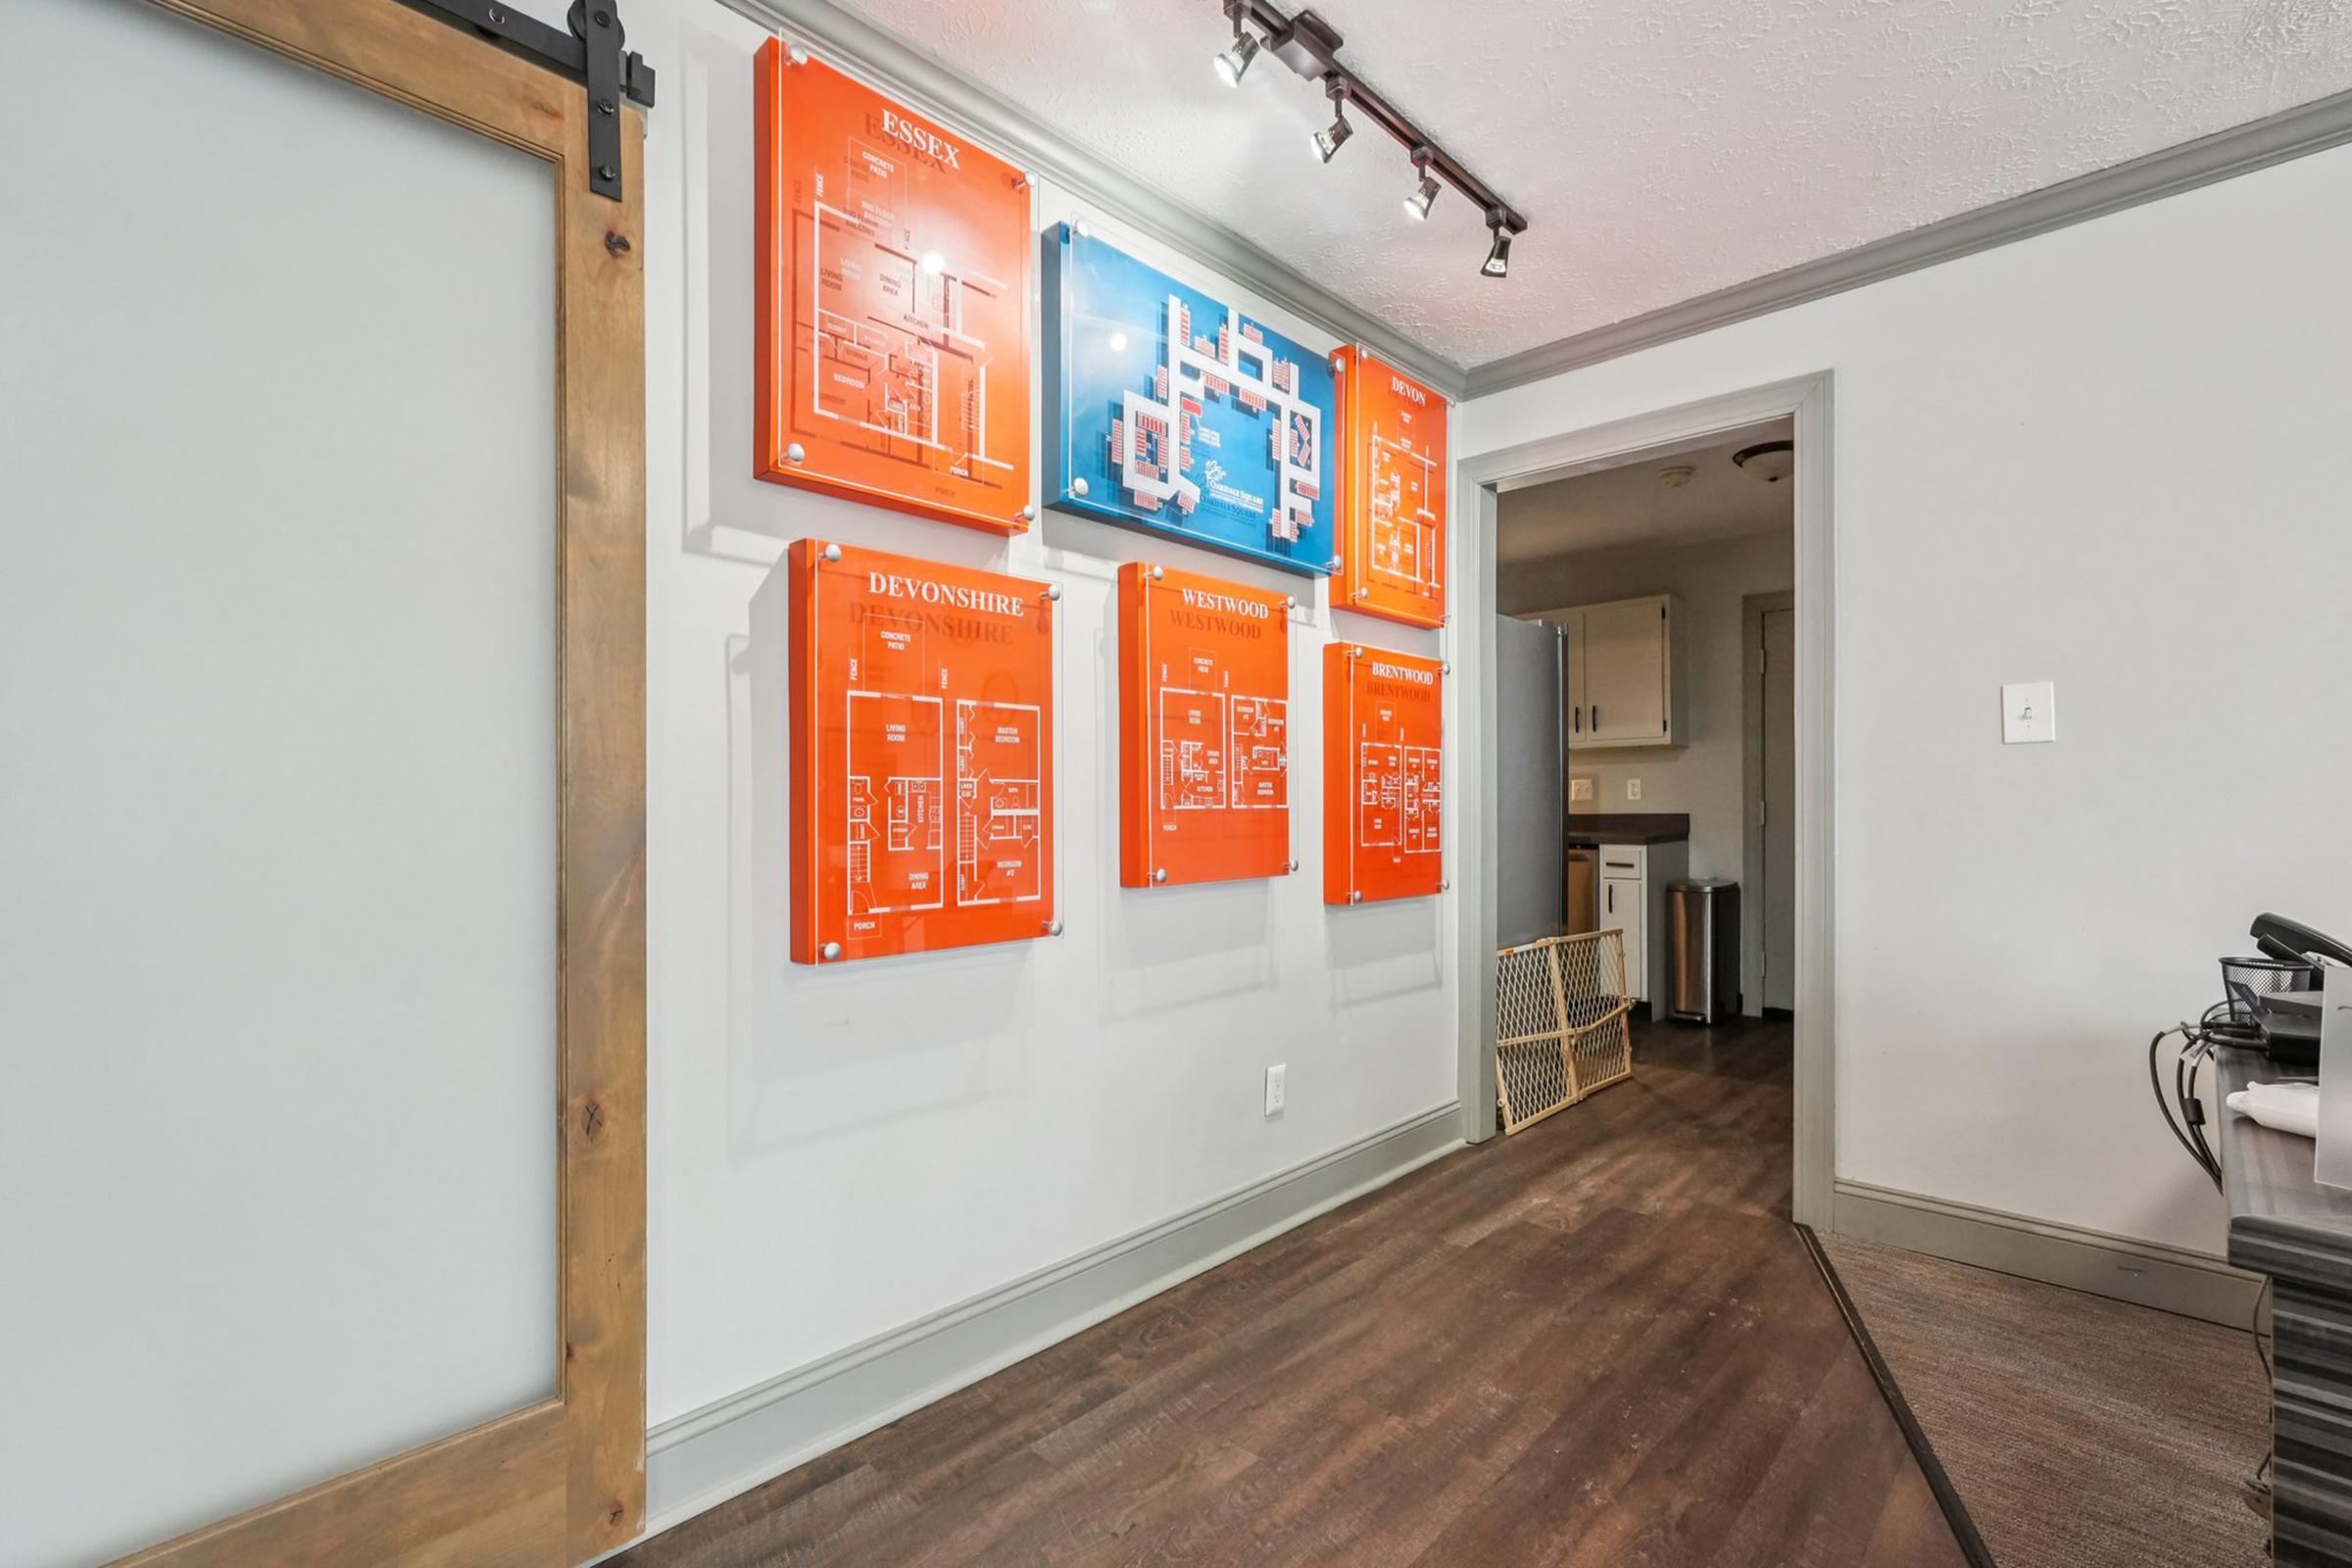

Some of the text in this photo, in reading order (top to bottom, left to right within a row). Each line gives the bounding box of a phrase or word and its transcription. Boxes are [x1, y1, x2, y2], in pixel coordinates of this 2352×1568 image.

[882, 108, 960, 171] ESSEX
[1392, 376, 1425, 406] DEVON
[869, 571, 1024, 616] DEVONSHIRE
[1182, 588, 1268, 619] WESTWOOD
[1372, 662, 1434, 685] BRENTWOOD
